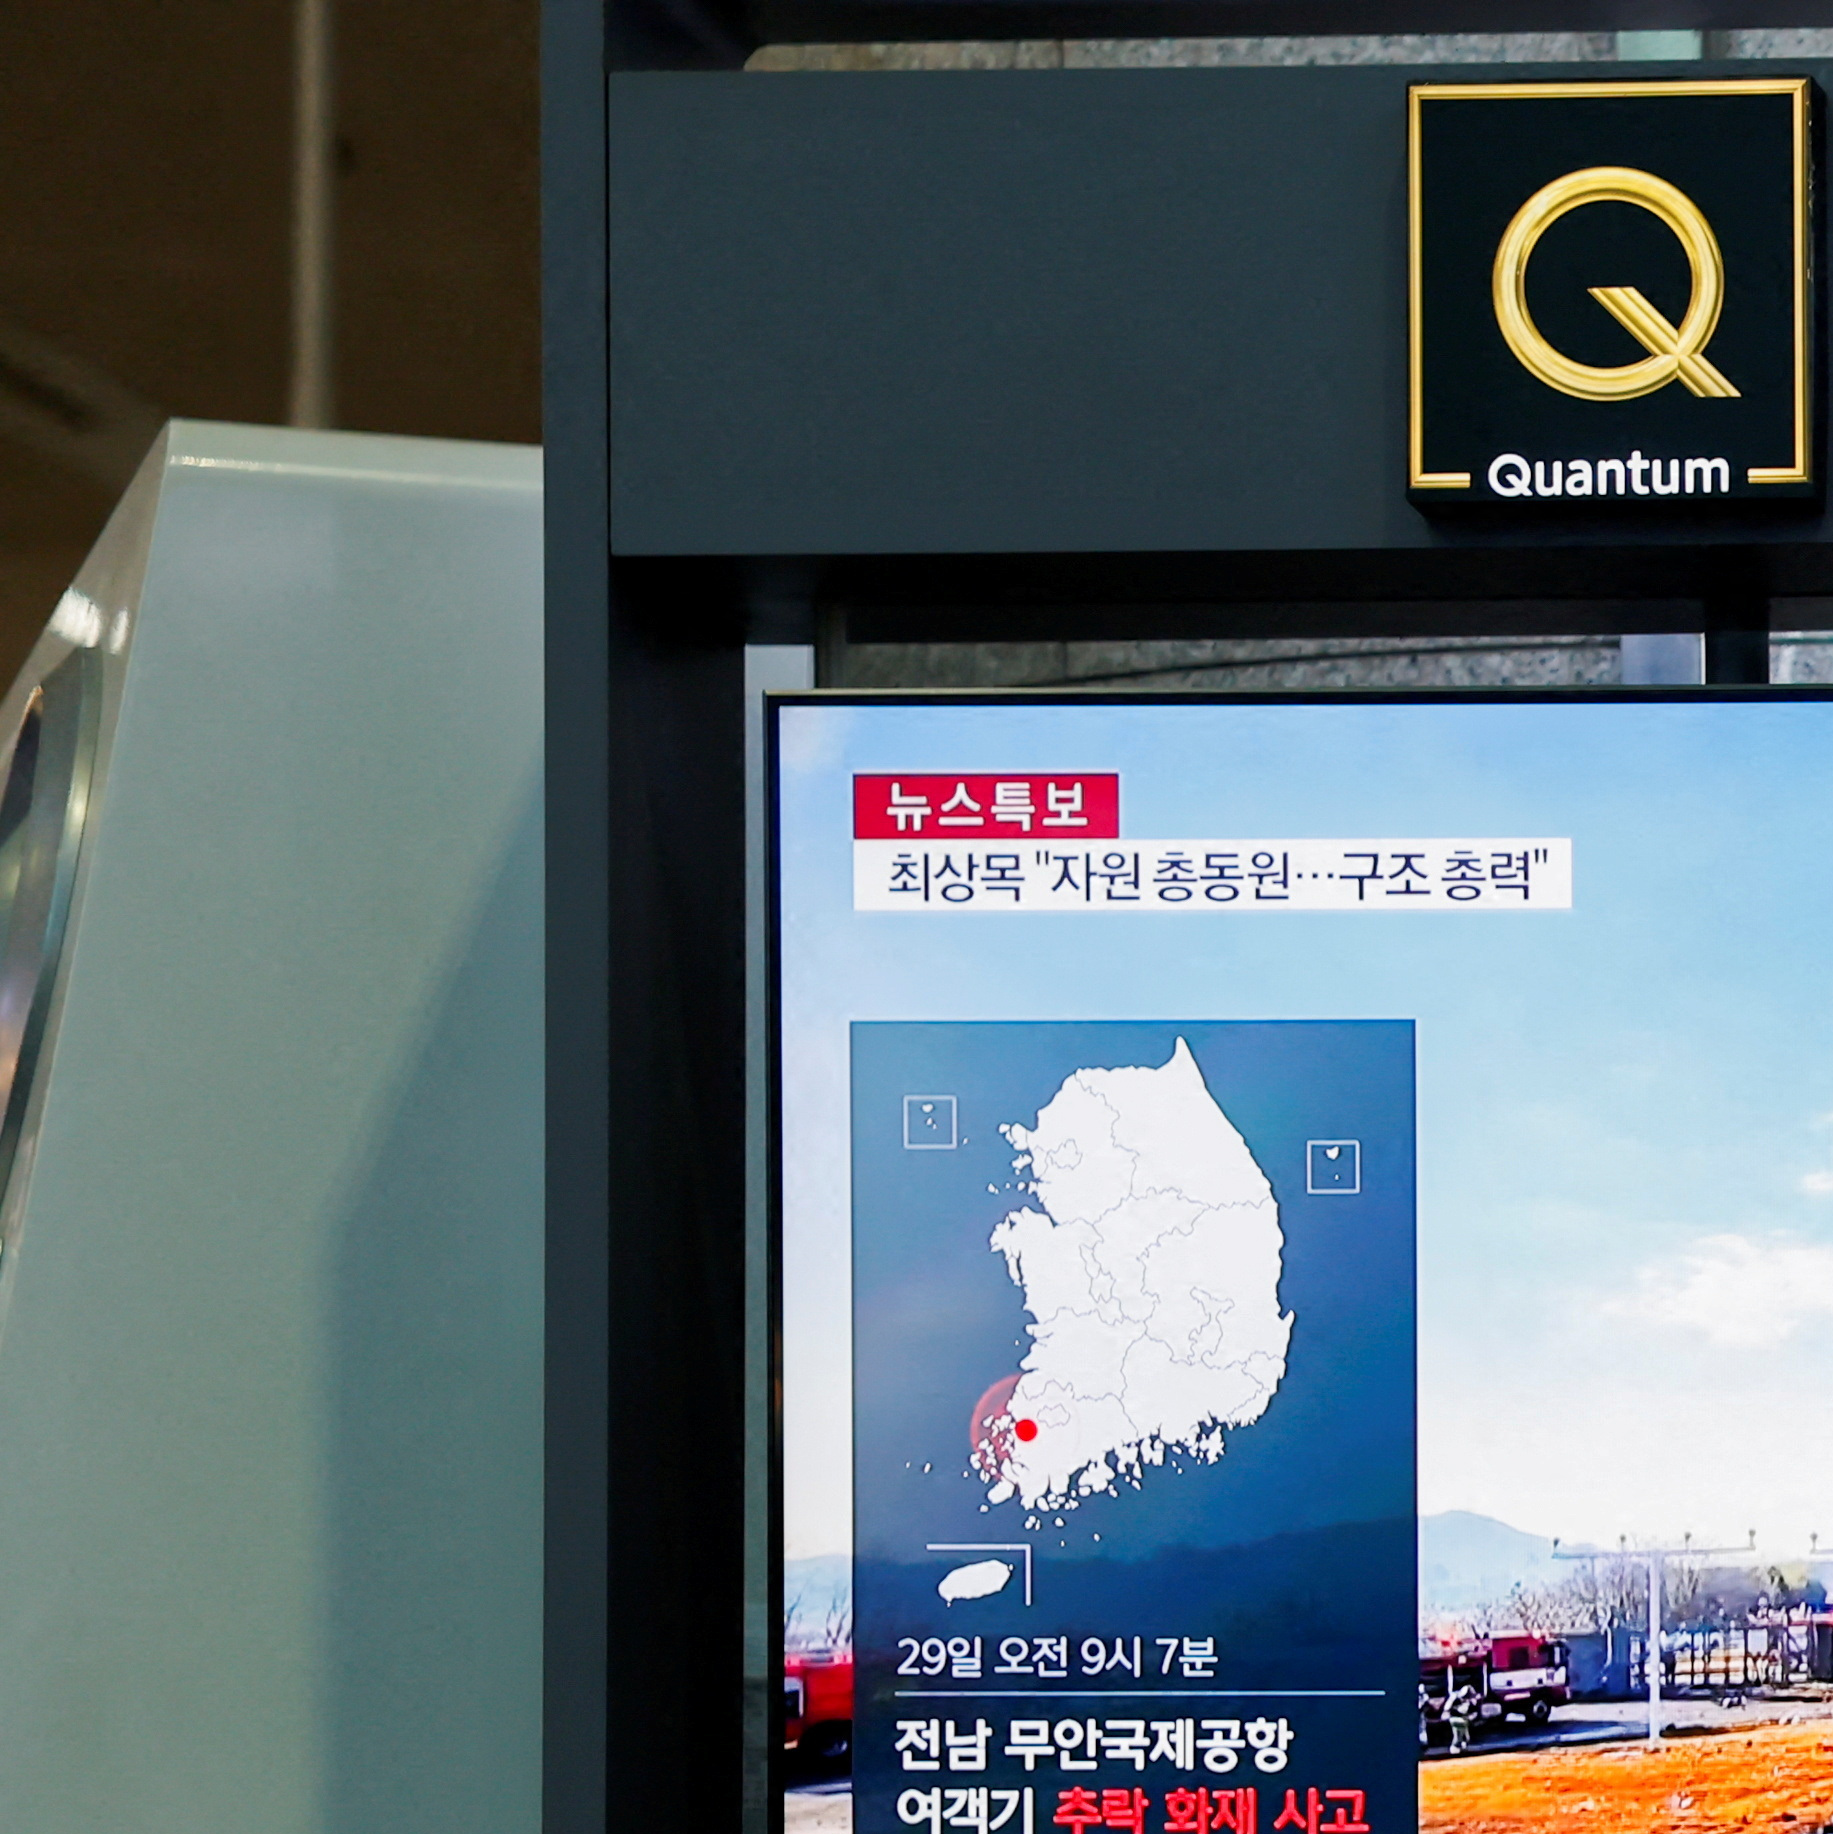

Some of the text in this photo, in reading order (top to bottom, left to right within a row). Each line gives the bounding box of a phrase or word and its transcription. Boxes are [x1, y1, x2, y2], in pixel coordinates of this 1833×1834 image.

[1489, 451, 1729, 496] Quantum
[887, 783, 1087, 831] 뉴스특보
[890, 854, 1023, 901] 최상목
[1037, 852, 1139, 901] "자원
[1442, 850, 1547, 900] 총력"
[898, 1637, 1217, 1677] 29일 오전 9시 7분
[896, 1718, 1293, 1772] 전남 무안국제공항
